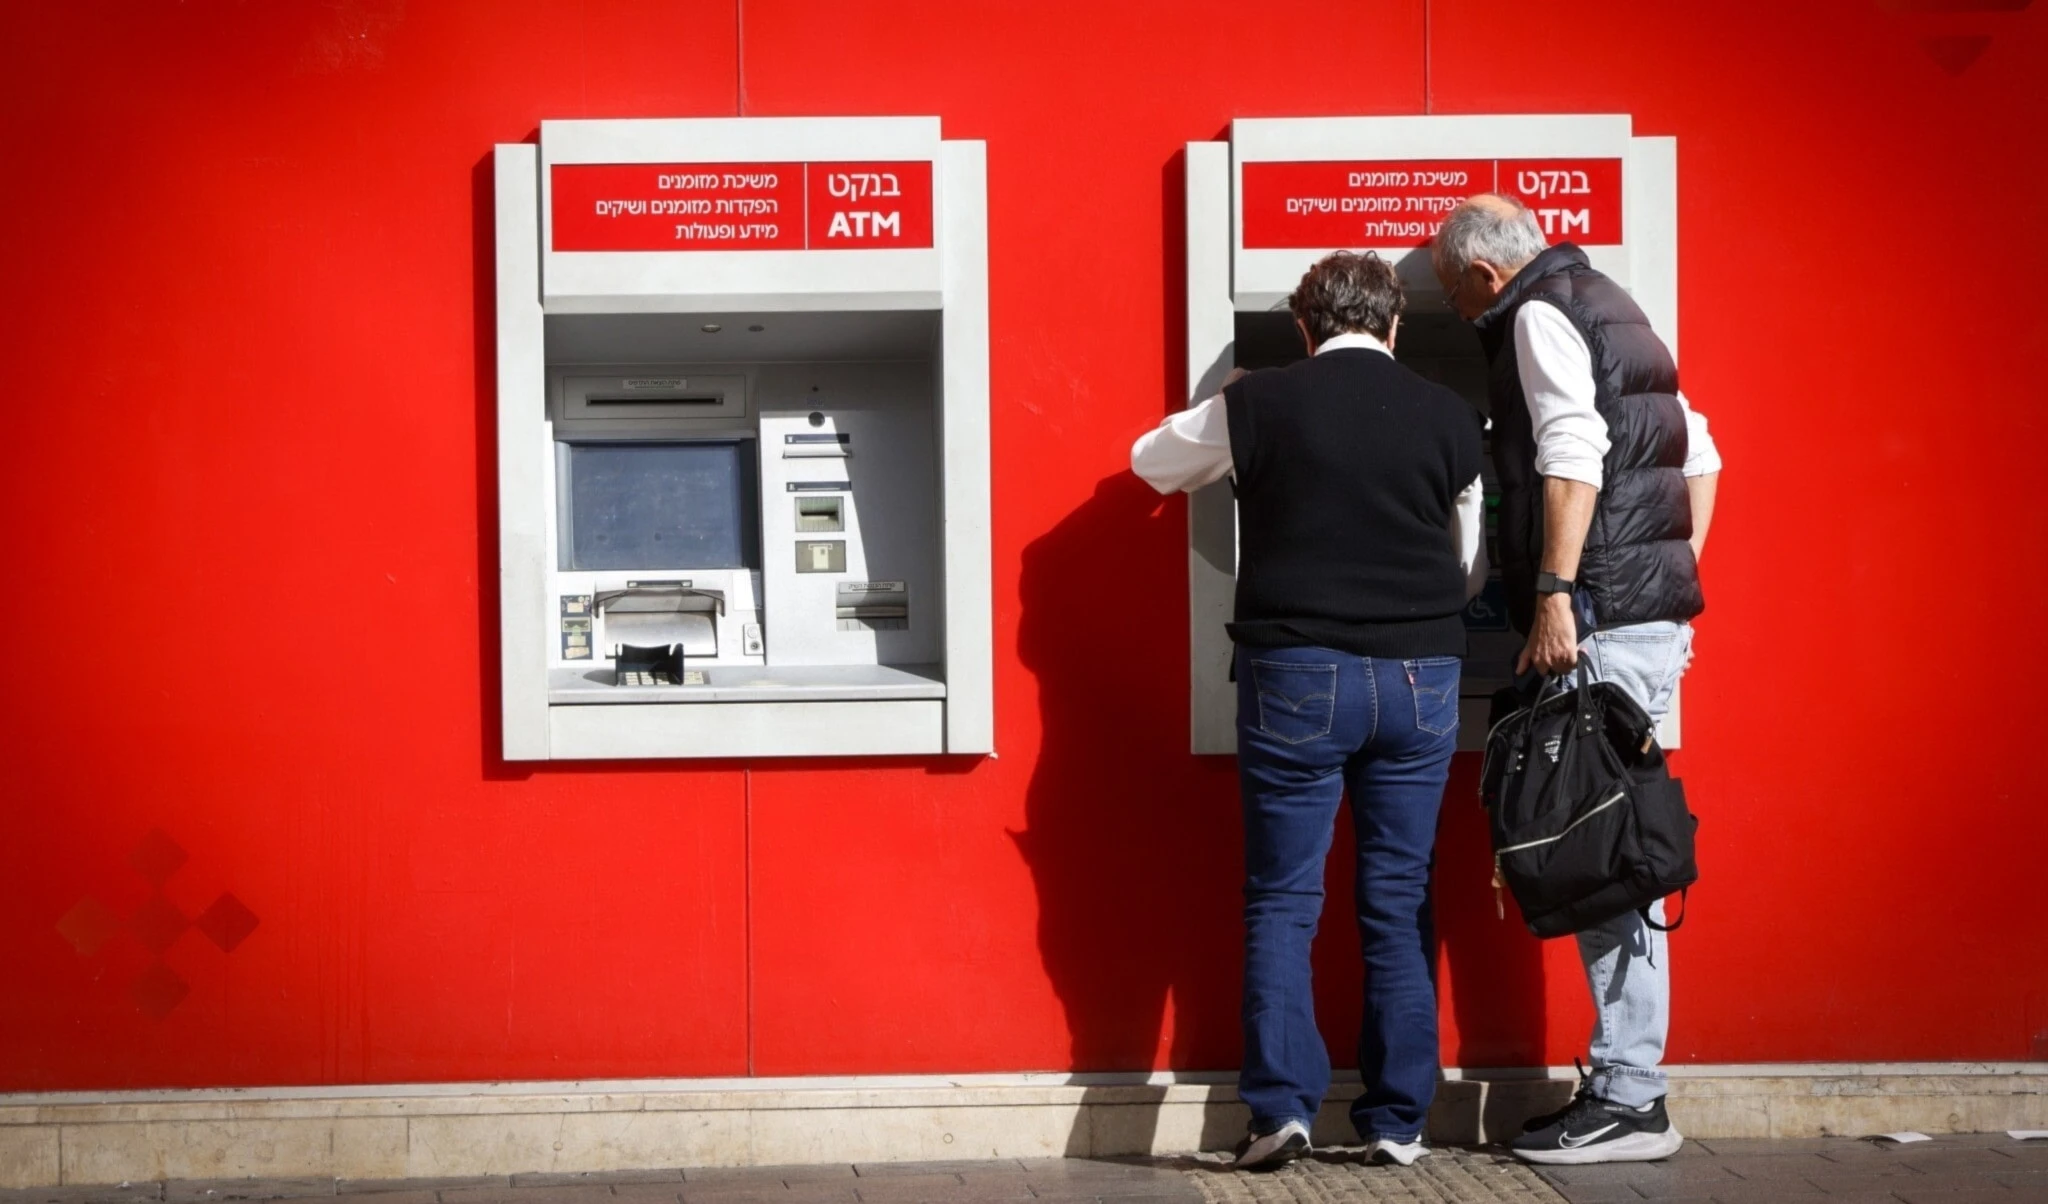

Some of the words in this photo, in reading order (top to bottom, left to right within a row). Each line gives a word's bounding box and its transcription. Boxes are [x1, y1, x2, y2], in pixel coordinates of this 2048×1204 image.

[657, 174, 720, 189] מזומנים
[722, 173, 778, 189] משיכת
[827, 172, 901, 201] בנקט
[1347, 171, 1410, 187] מזומנים
[1413, 171, 1468, 187] משיכת
[1517, 170, 1591, 200] בנקט
[595, 200, 647, 217] ושיקים
[650, 199, 713, 215] מזומנים
[715, 199, 778, 217] הפקדות
[1286, 198, 1337, 215] ושיקים
[1340, 197, 1403, 213] מזומנים
[827, 211, 901, 238] ATM
[1365, 219, 1426, 237] ופעולות
[1536, 207, 1591, 235] TM
[675, 221, 736, 239] ופעולות
[739, 223, 779, 239] מידע
